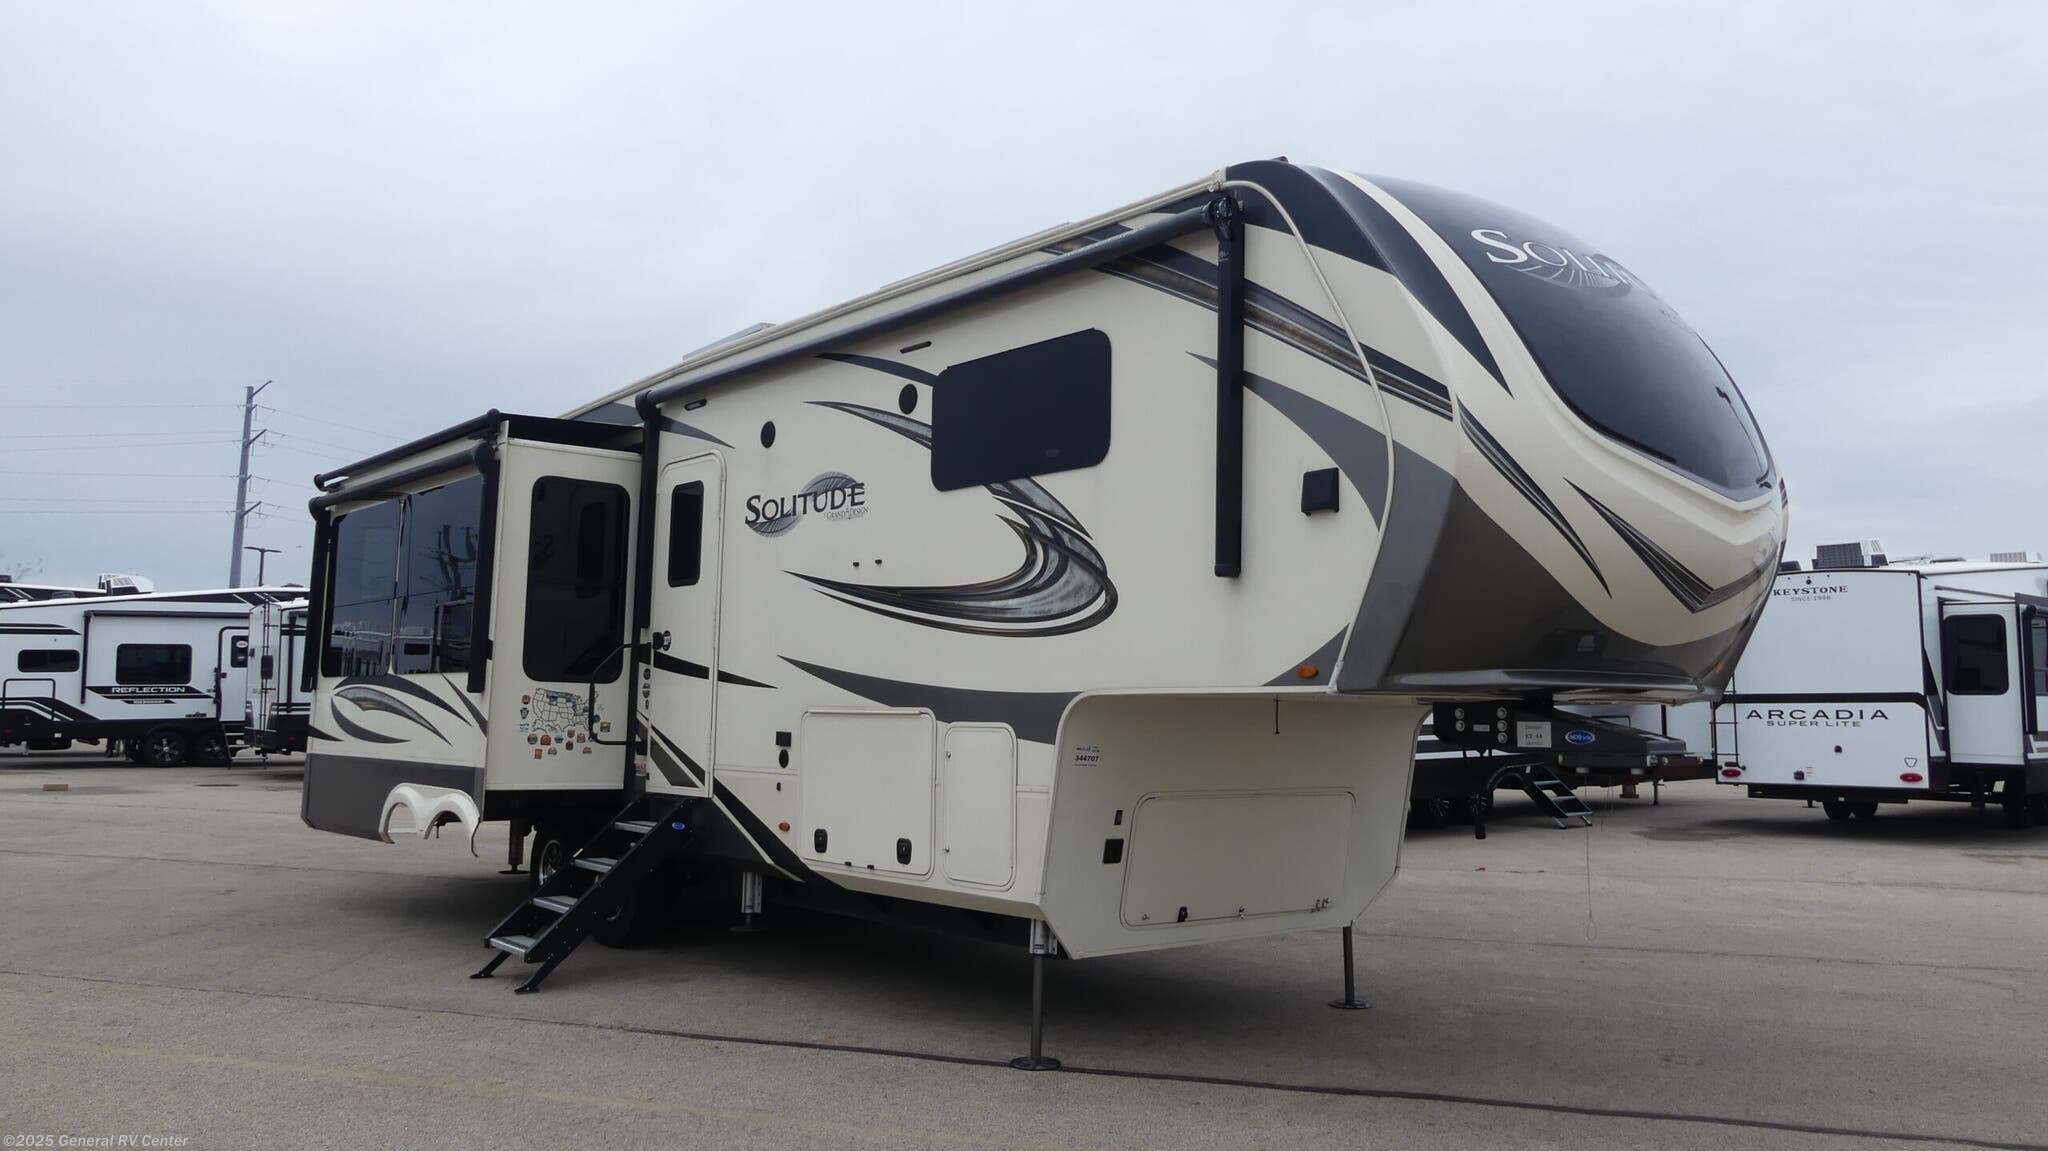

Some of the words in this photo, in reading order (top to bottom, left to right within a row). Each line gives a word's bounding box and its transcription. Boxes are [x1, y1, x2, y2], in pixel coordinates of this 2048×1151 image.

[745, 482, 865, 524] SOLITUDE
[1773, 587, 1848, 596] KEYSTONE
[1746, 709, 1889, 720] ARCADIA
